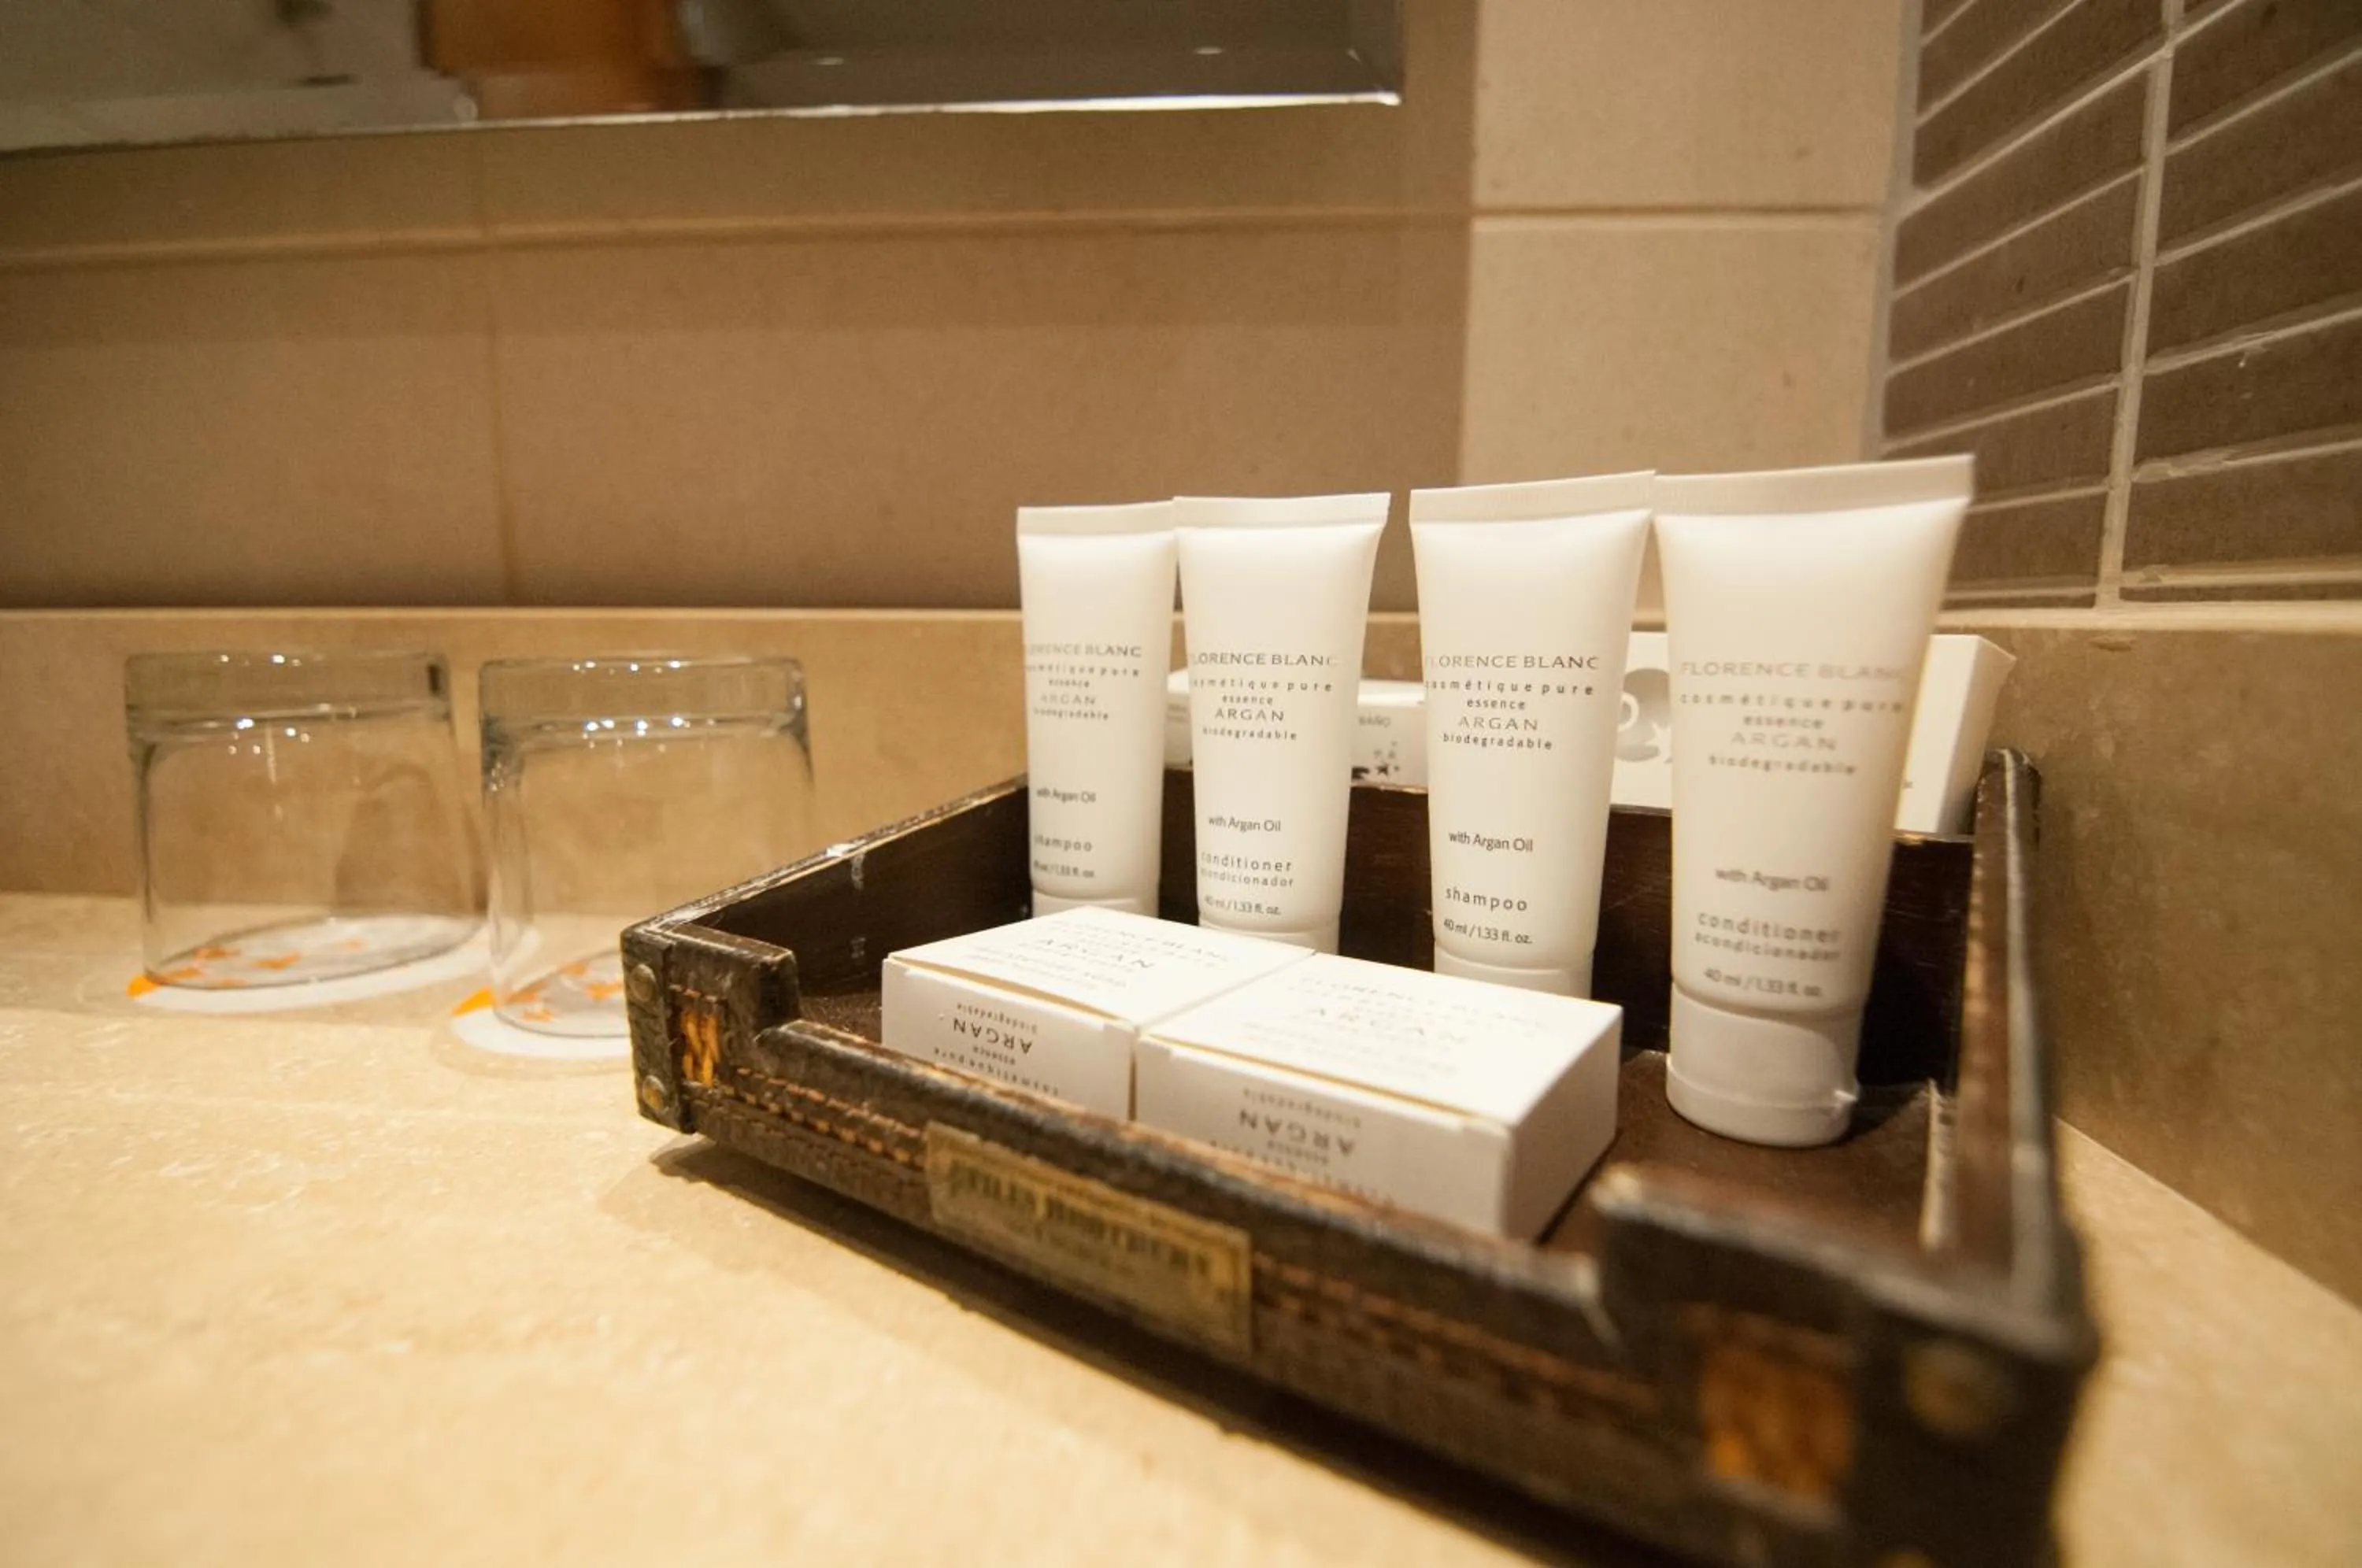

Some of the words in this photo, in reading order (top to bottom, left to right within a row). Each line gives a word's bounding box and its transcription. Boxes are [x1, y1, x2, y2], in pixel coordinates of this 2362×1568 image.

[1084, 645, 1143, 658] BLANC
[1190, 652, 1267, 665] LORENCE
[1271, 653, 1339, 667] BLANC
[1523, 655, 1600, 670] BLANC
[1680, 661, 1812, 679] FLORENCE
[1287, 681, 1333, 693] pure
[1541, 683, 1594, 696] pure
[1039, 693, 1097, 706] ARGAN
[1222, 694, 1274, 706] essence
[1466, 697, 1526, 710] essence
[1841, 699, 1905, 713] pure
[1214, 707, 1286, 723] ARGAN
[1457, 716, 1538, 731] ARGAN
[1202, 726, 1298, 741] biodegradable
[1442, 732, 1553, 750] biodegradable
[1731, 731, 1837, 751] ARGAN
[1052, 788, 1079, 804] Argan
[1080, 791, 1097, 804] Oil
[1209, 815, 1227, 827] with
[1227, 816, 1261, 833] Argan
[1264, 819, 1282, 832] Oil
[1448, 830, 1471, 845] with
[1472, 833, 1510, 852] Argan
[1512, 837, 1534, 852] Oil
[1200, 851, 1293, 872] conditioner
[1715, 868, 1748, 883] with
[1751, 871, 1801, 892] Argan
[1803, 875, 1831, 892] Oil
[1445, 886, 1528, 912] shampoo
[1697, 912, 1842, 944] conditioner
[953, 1018, 1033, 1055] ARGAN
[1239, 1108, 1356, 1157] ARGAN
